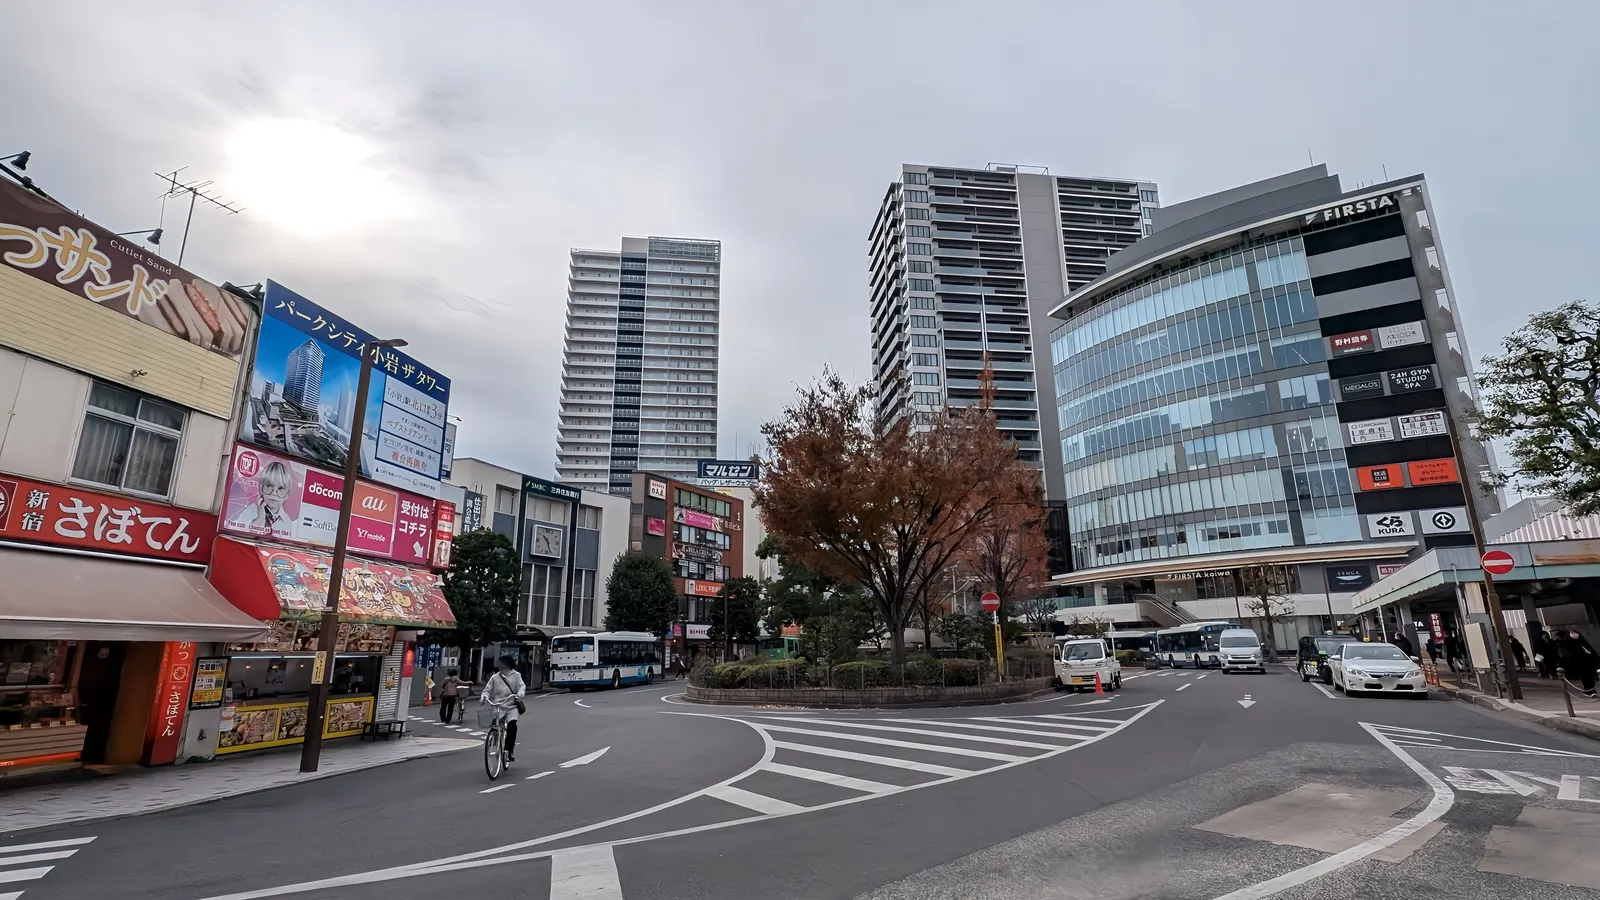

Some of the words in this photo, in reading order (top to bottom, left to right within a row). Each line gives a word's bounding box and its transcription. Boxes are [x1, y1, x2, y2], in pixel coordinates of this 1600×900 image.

[1323, 195, 1394, 221] FIRSTA
[110, 239, 144, 262] Cutlet
[146, 257, 172, 276] Sand
[1390, 371, 1407, 380] 24H
[1410, 368, 1430, 376] GYM
[1395, 375, 1427, 384] STUDIO
[1344, 381, 1379, 392] MEGALOS
[1404, 381, 1421, 389] SPA
[309, 482, 343, 501] docom
[531, 482, 547, 492] SMBC
[21, 488, 50, 532] 新宿
[362, 495, 387, 512] au
[400, 500, 430, 519] 受付は
[53, 497, 200, 554] さぼてん
[398, 519, 427, 537] コチラ
[1378, 527, 1405, 535] KURA
[1174, 572, 1202, 580] FIRSTA
[161, 691, 181, 737] さぼてん
